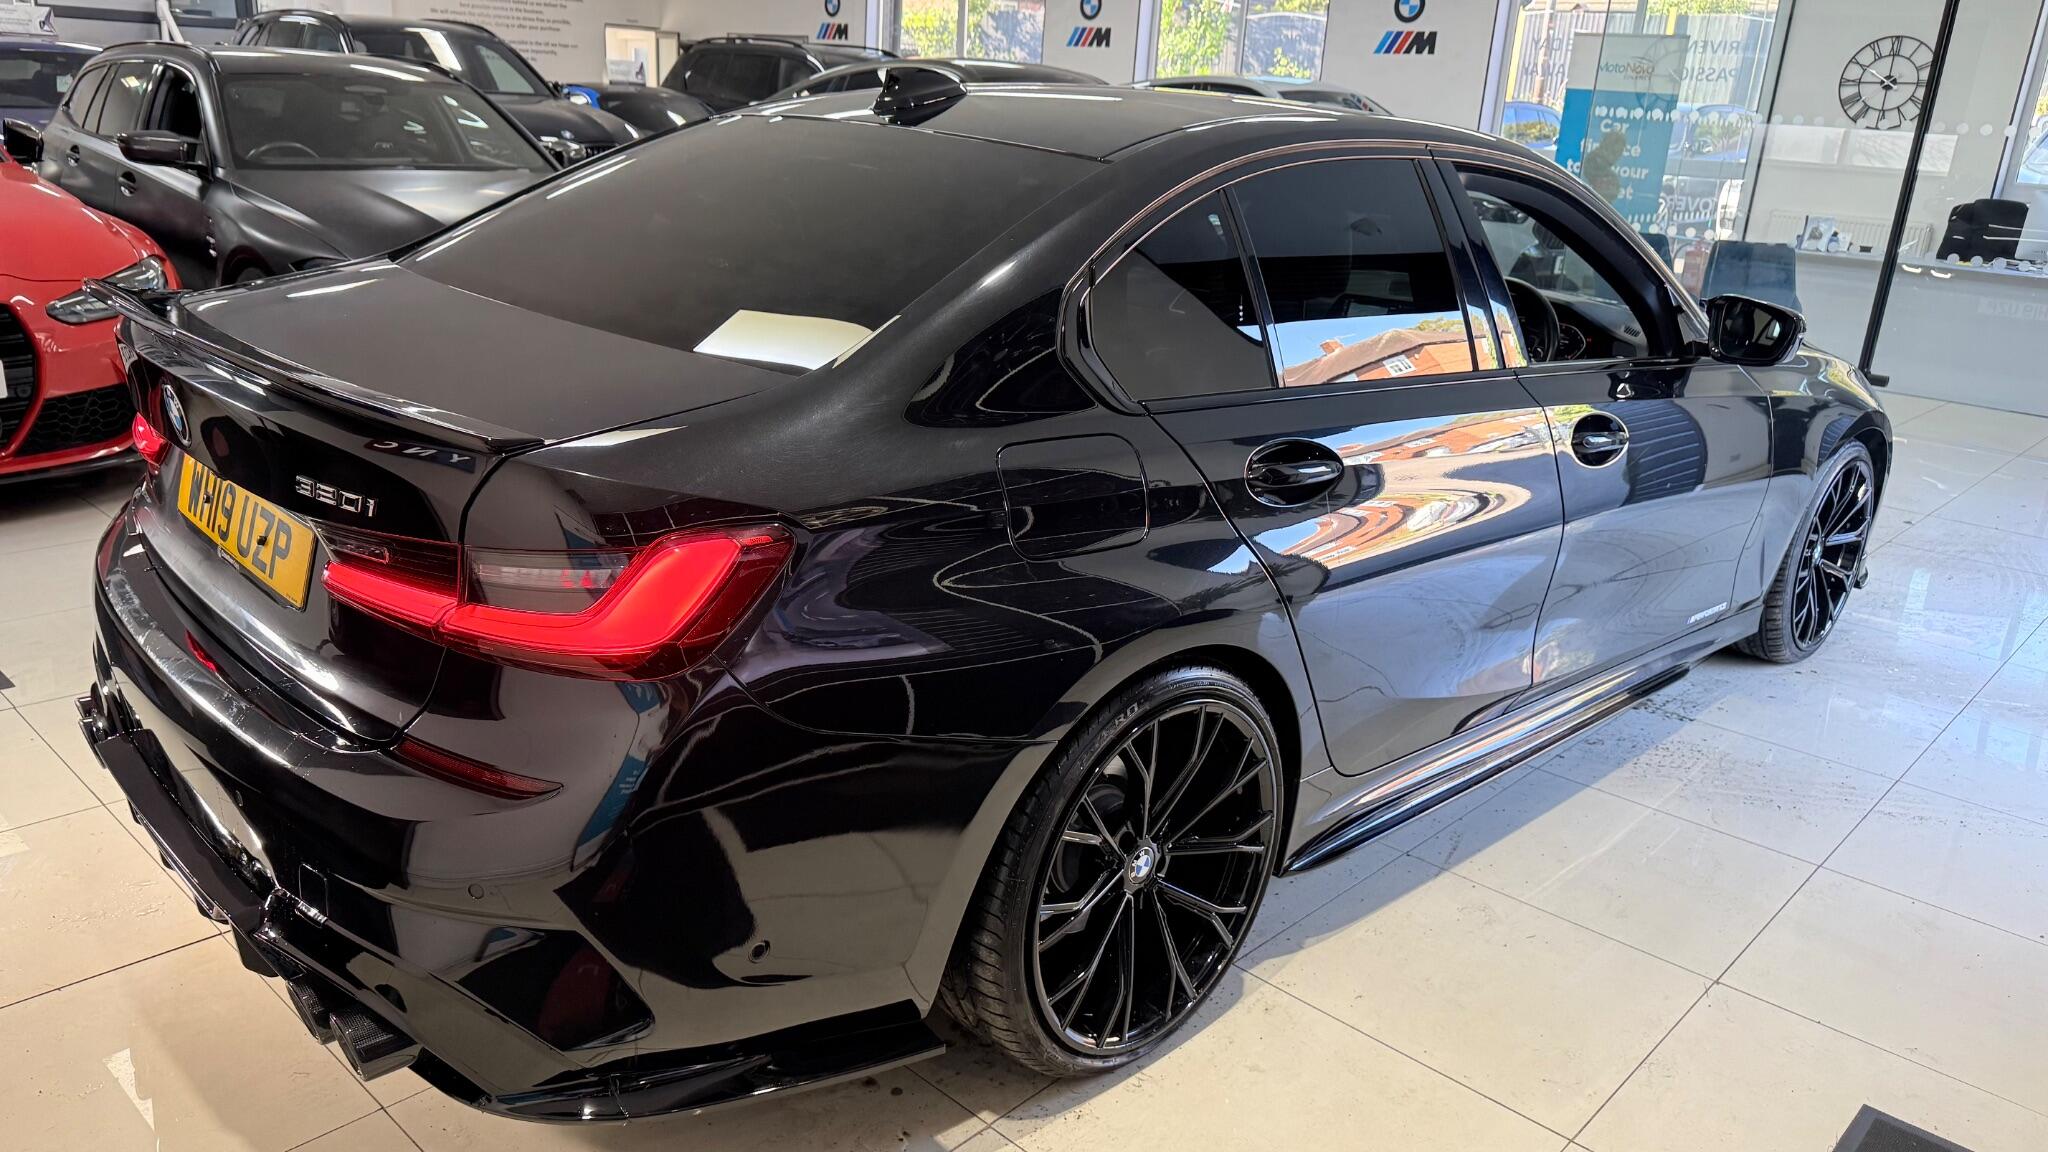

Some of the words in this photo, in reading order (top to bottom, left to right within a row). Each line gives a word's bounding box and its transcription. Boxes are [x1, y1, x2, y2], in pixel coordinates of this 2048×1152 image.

[1600, 119, 1629, 134] Car
[188, 460, 237, 542] WH19
[237, 494, 292, 580] UZP
